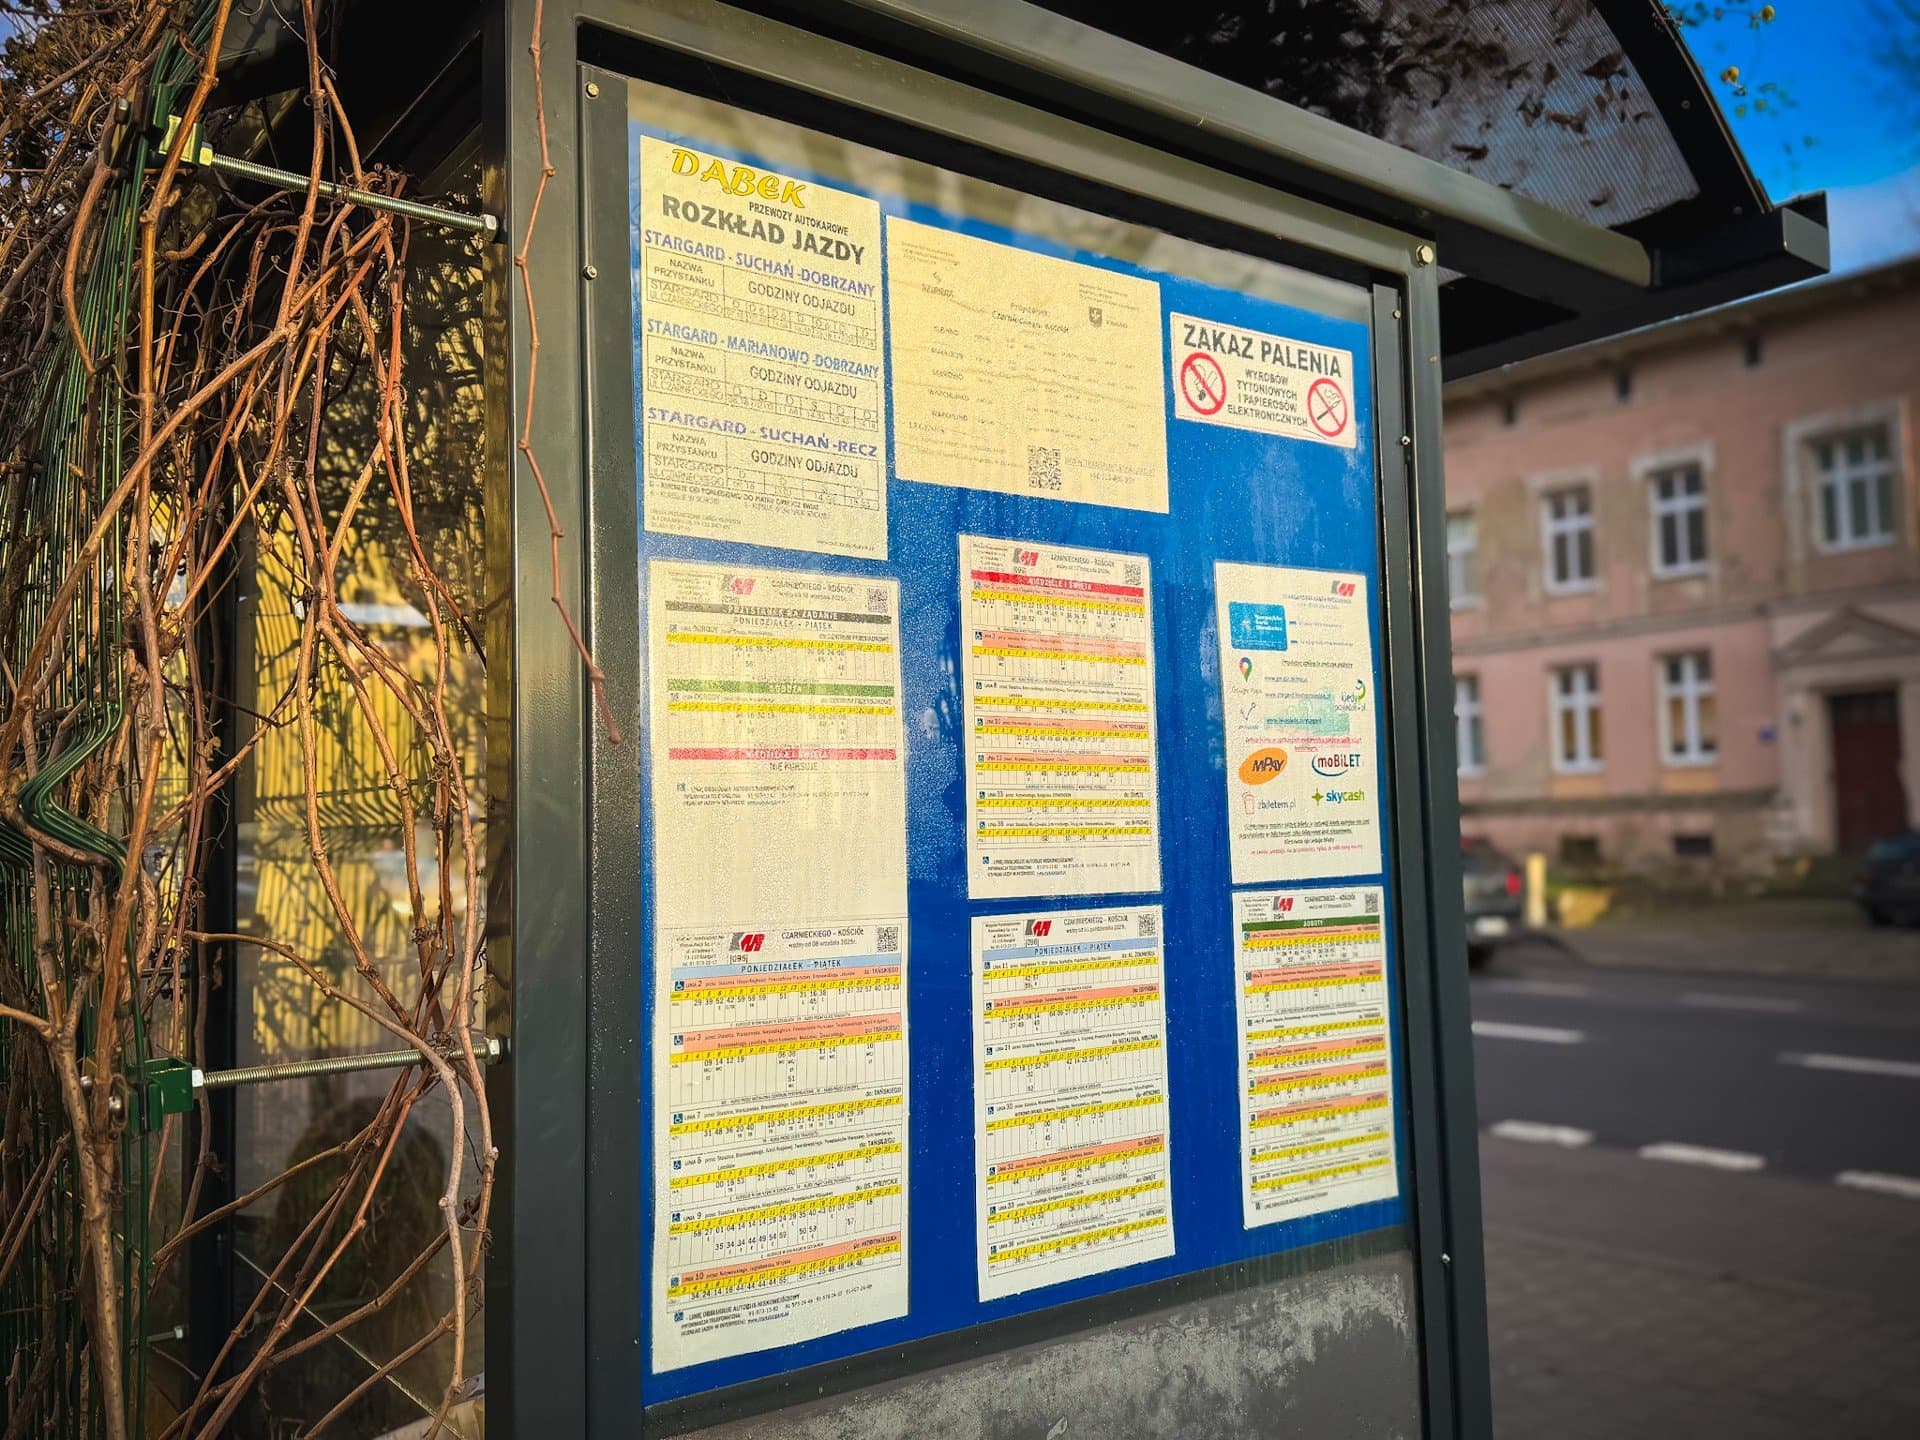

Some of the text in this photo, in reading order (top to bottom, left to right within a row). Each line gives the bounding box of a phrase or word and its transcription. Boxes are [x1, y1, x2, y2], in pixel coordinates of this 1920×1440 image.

[662, 194, 785, 245] ROZKŁAD
[792, 229, 864, 265] JAZDY
[749, 201, 848, 236] PRZEWOZY AUTOKAROWE
[645, 230, 725, 261] STARGARD
[736, 253, 794, 279] SUCHAŃ
[654, 266, 715, 288] PRZYSTANKU
[670, 258, 703, 274] NAZWA
[748, 281, 800, 305] GODZINY
[803, 294, 855, 317] ODJAZDU
[647, 318, 718, 345] STARGARD
[727, 335, 810, 365] MARIANOWO
[1184, 324, 1342, 378] ZAKAZ PALENIA
[671, 346, 705, 360] NAZWA
[656, 355, 716, 374] PRZYSTANKU
[750, 366, 857, 400] GODZINY ODJAZDU
[1245, 369, 1288, 385] WYROBÓW
[1237, 380, 1297, 400] TYTONIOWYCH
[1243, 393, 1297, 413] PAPIEROSÓW
[1227, 404, 1308, 426] ELEKTRONICZNYCH
[648, 407, 747, 436] STARGARD
[759, 426, 829, 449] SUCHAŃ
[672, 433, 706, 446] NAZWA
[751, 450, 858, 478] GODZINY ODJAZDU
[1326, 789, 1365, 805] skycash
[781, 930, 832, 940] CZARNIECKIEGO
[838, 926, 865, 937] KOŚCIÓŁ
[741, 962, 803, 973] PONIEDZIAŁEK
[814, 959, 841, 970] PIĄTEK
